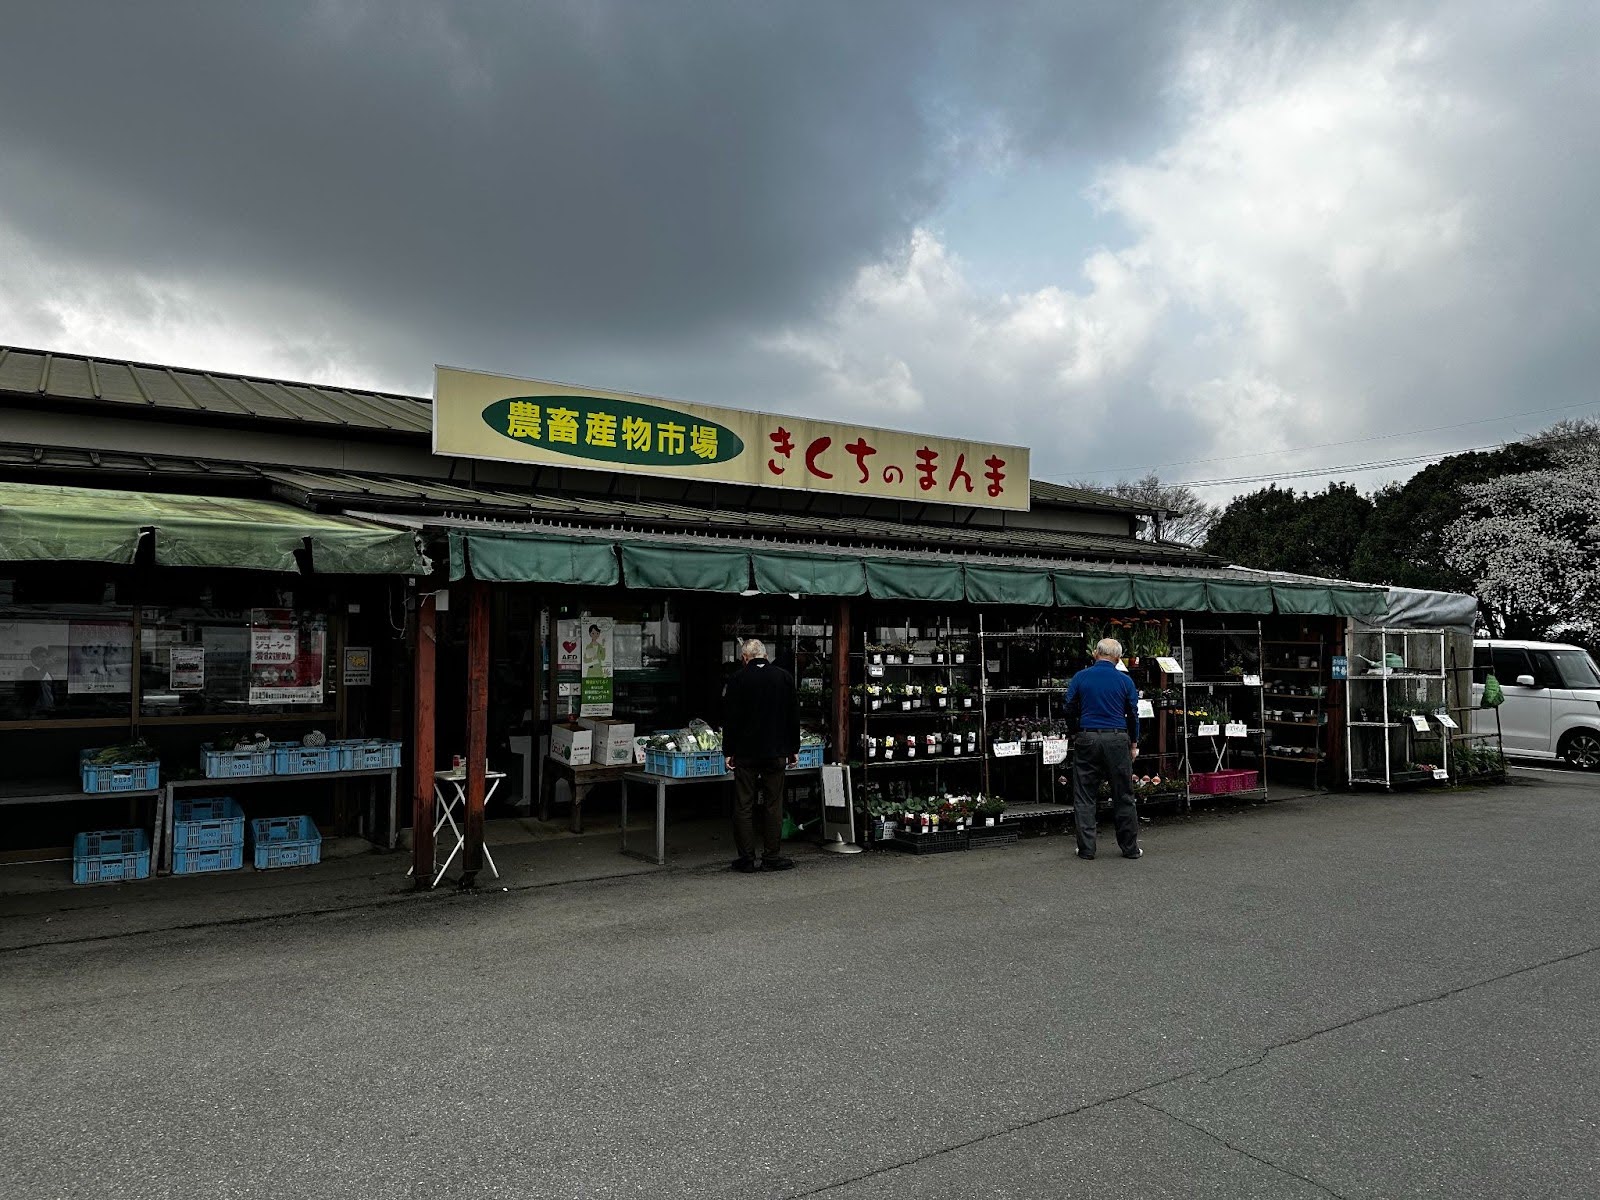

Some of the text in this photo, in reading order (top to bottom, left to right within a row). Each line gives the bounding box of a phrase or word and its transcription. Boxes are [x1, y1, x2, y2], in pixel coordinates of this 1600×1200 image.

[507, 400, 719, 460] 農畜産物市場
[767, 426, 1007, 498] きくちのまんま
[255, 641, 291, 650] ジューシー
